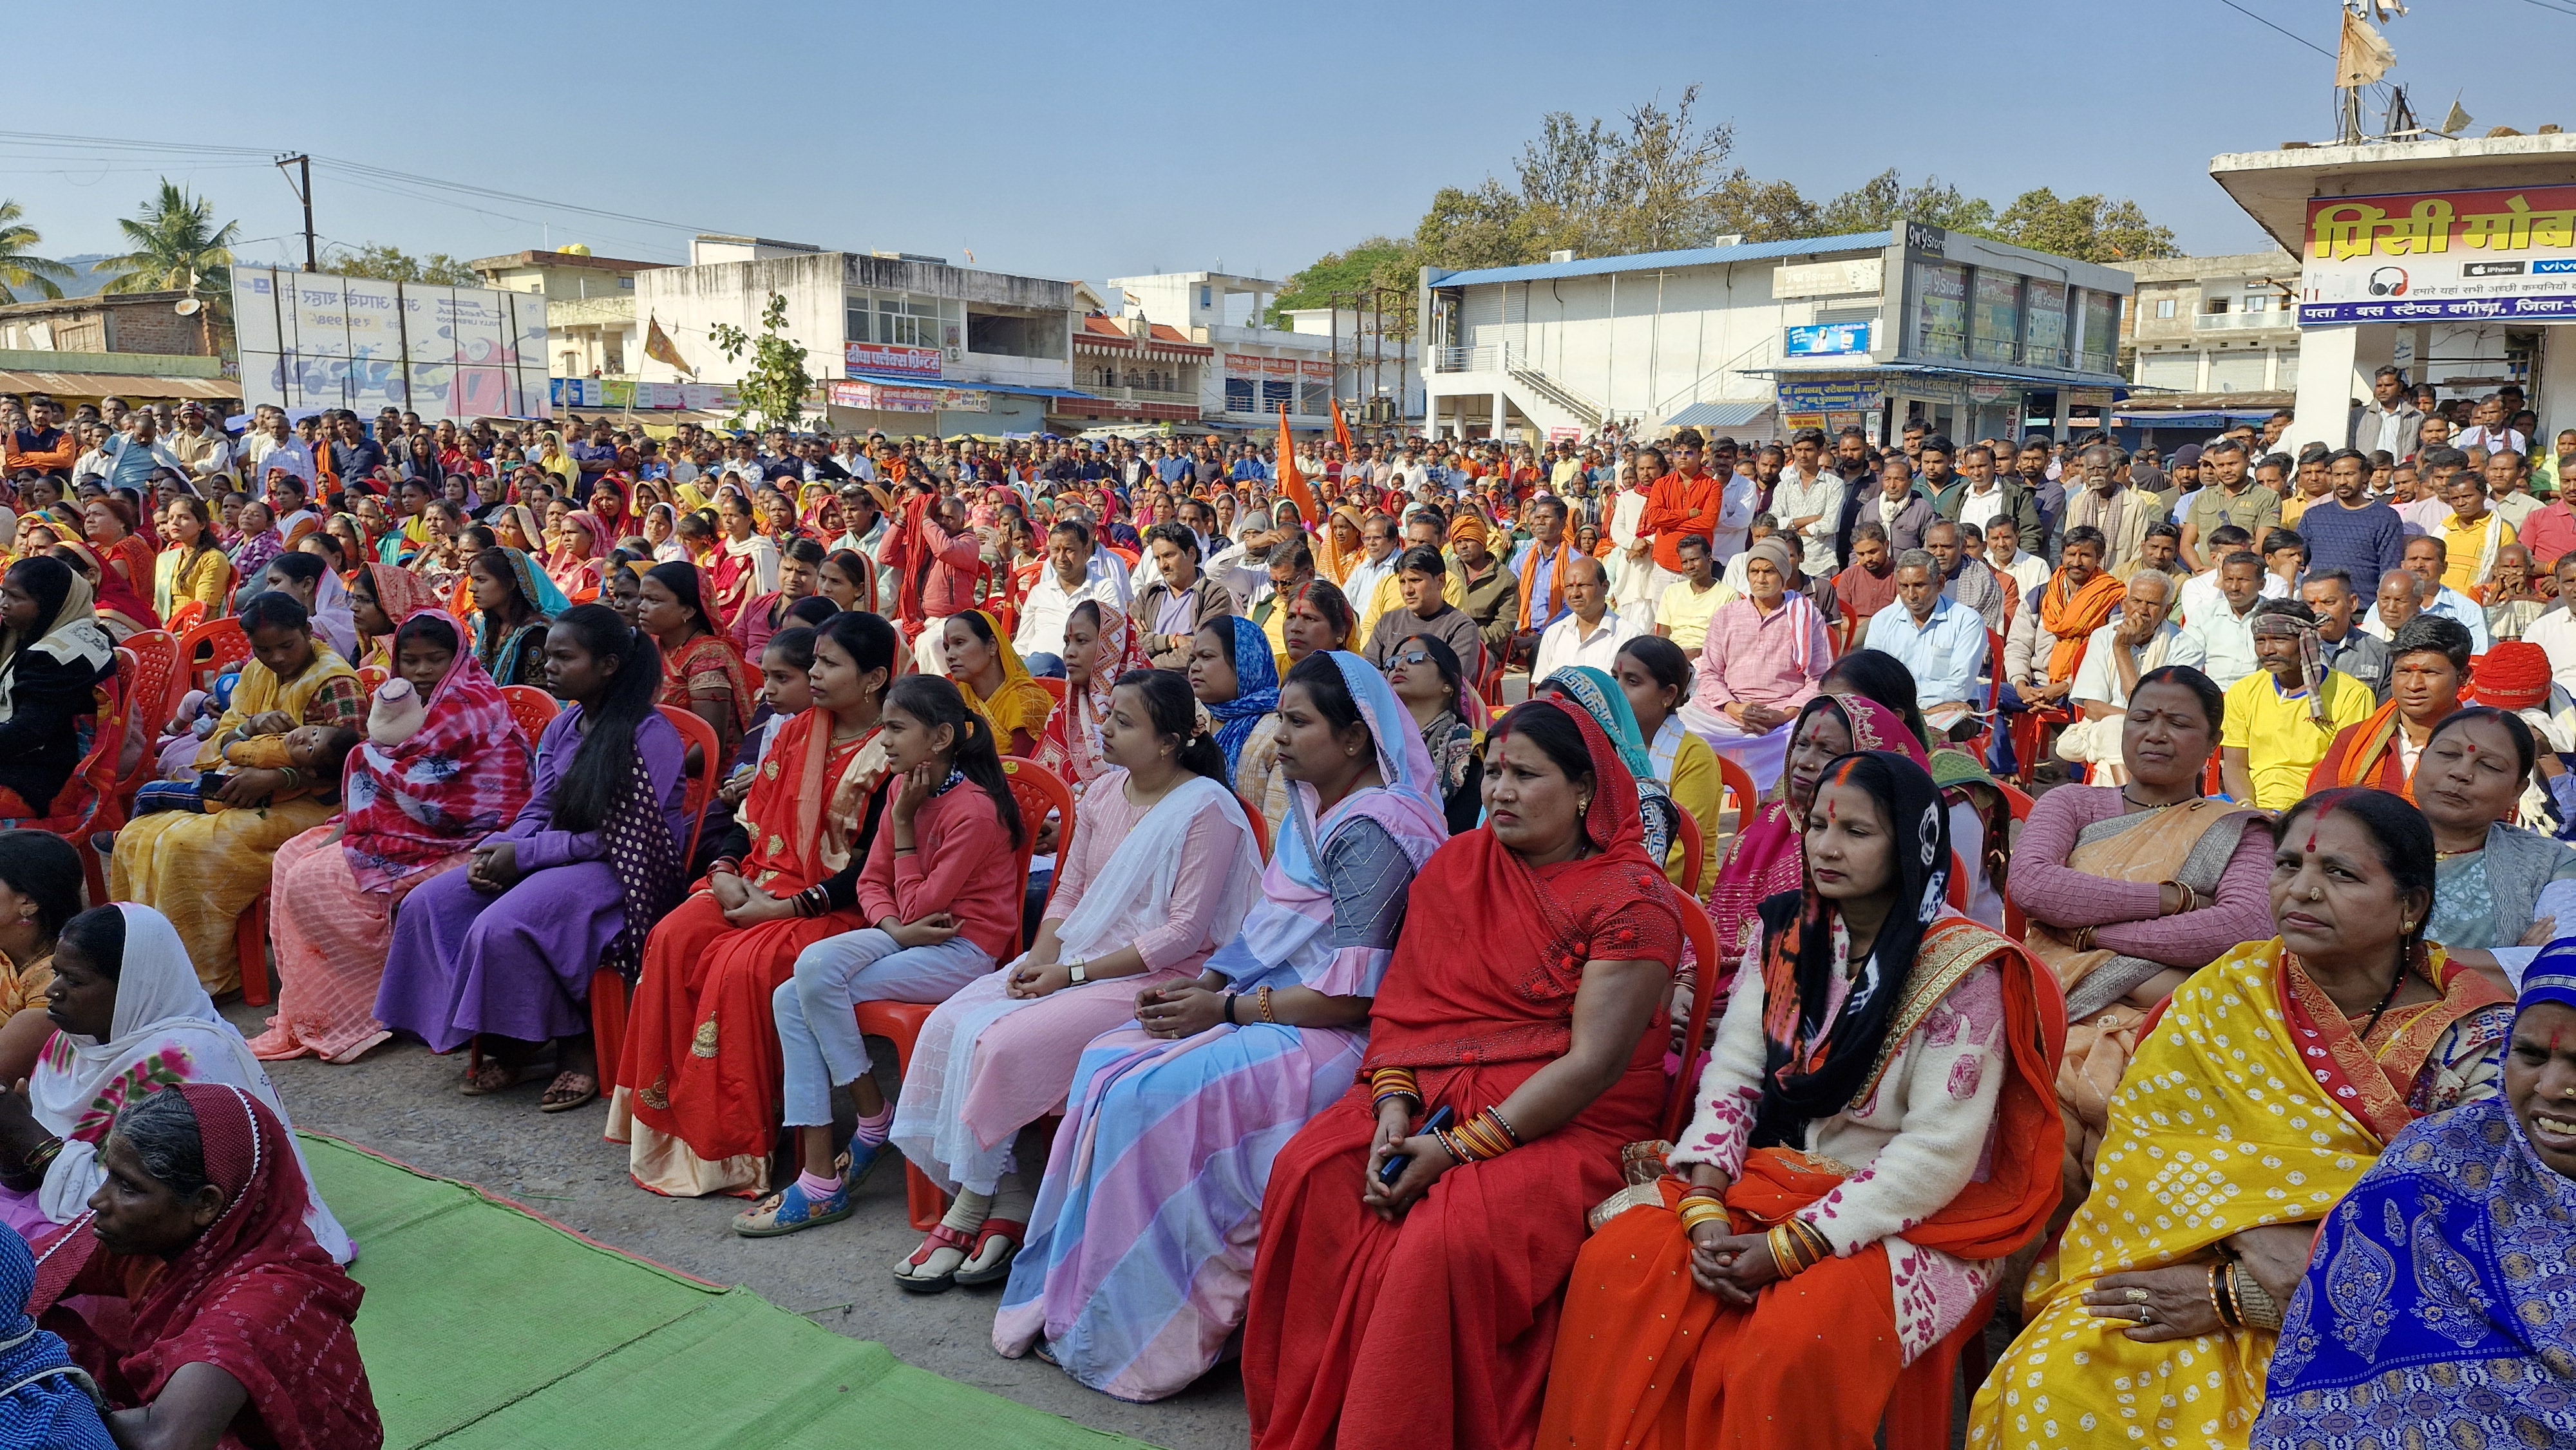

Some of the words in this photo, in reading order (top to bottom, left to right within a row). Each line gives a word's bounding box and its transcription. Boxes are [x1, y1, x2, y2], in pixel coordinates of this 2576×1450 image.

[2412, 285, 2436, 296] हमारे
[2440, 285, 2458, 295] यहां
[2463, 284, 2483, 294] सभी
[2488, 283, 2517, 293] अच्छी
[2521, 281, 2568, 291] कम्पनियों
[2304, 307, 2338, 319] पता
[2356, 304, 2385, 317] बस
[2391, 302, 2441, 315] स्टैण्ड
[846, 344, 871, 364] दीपा
